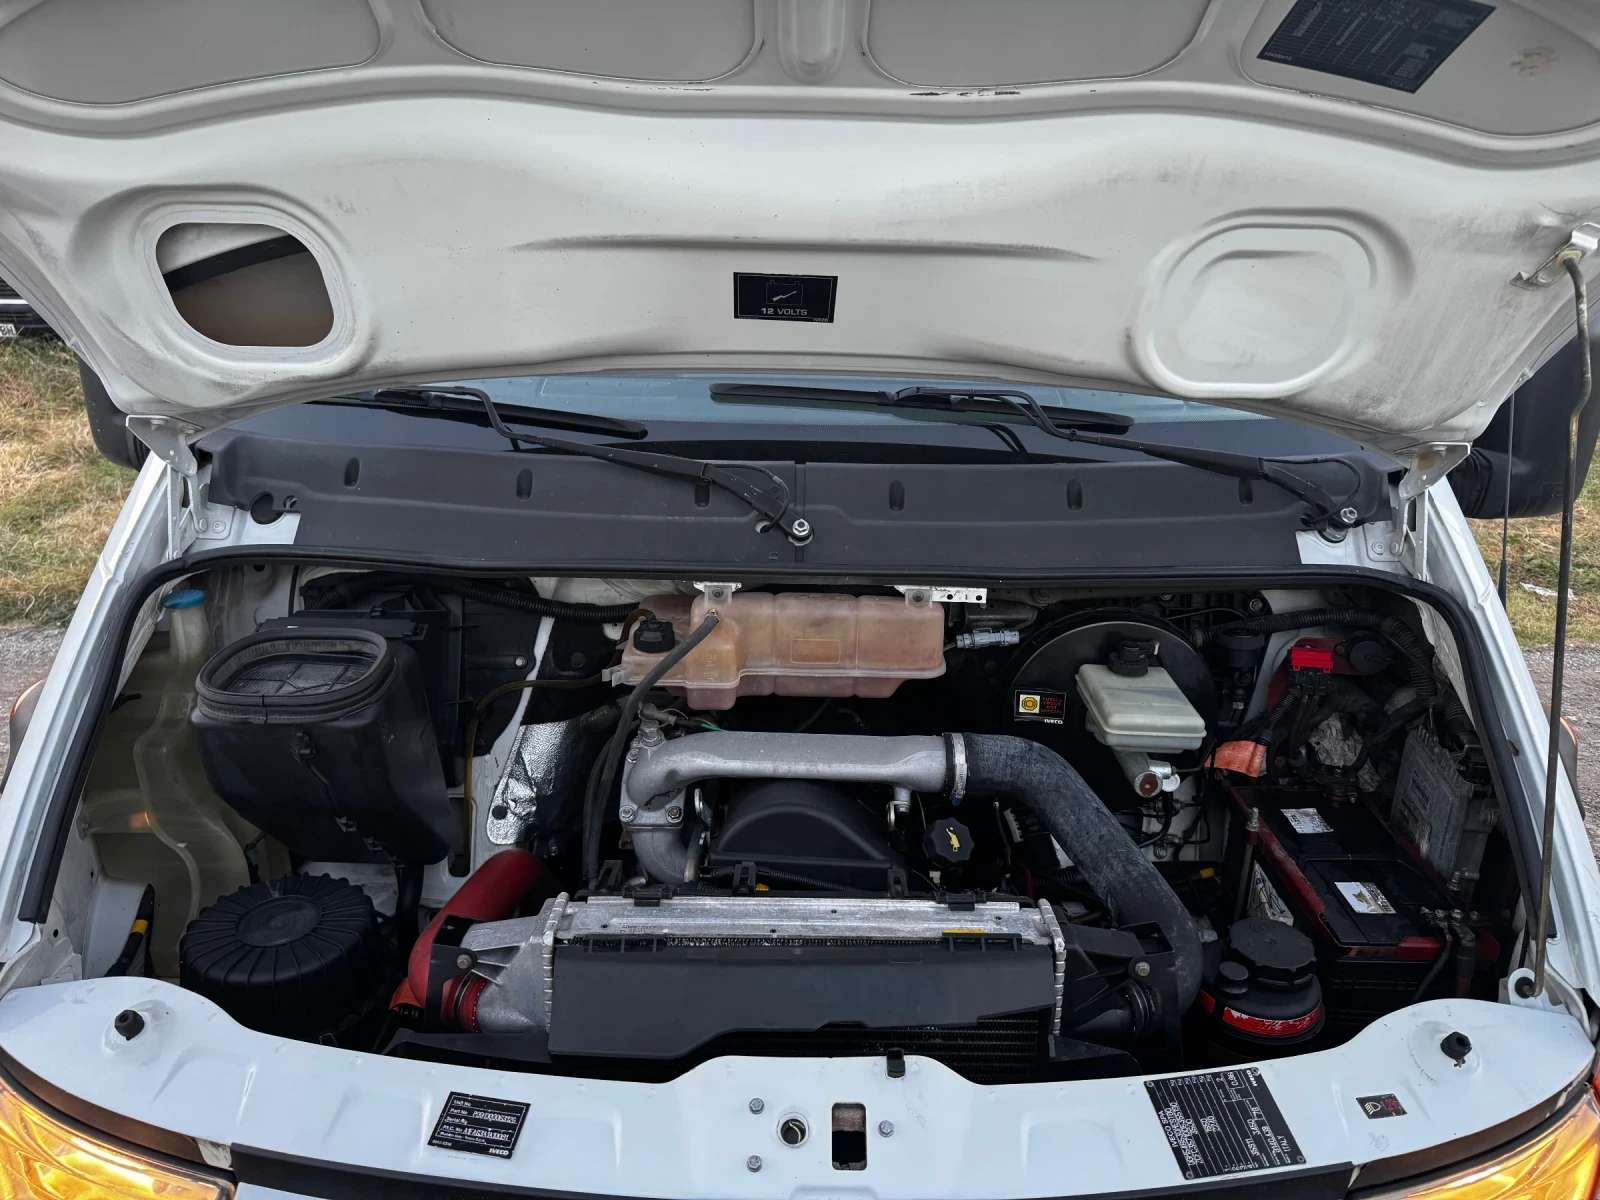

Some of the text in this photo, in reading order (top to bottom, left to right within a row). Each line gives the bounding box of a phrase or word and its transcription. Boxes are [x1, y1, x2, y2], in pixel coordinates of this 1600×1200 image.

[761, 307, 808, 316] 12 VOLTS
[1164, 1125, 1179, 1148] IVECO
[1276, 1135, 1292, 1152] ITALY
[488, 1147, 510, 1156] IVECO
